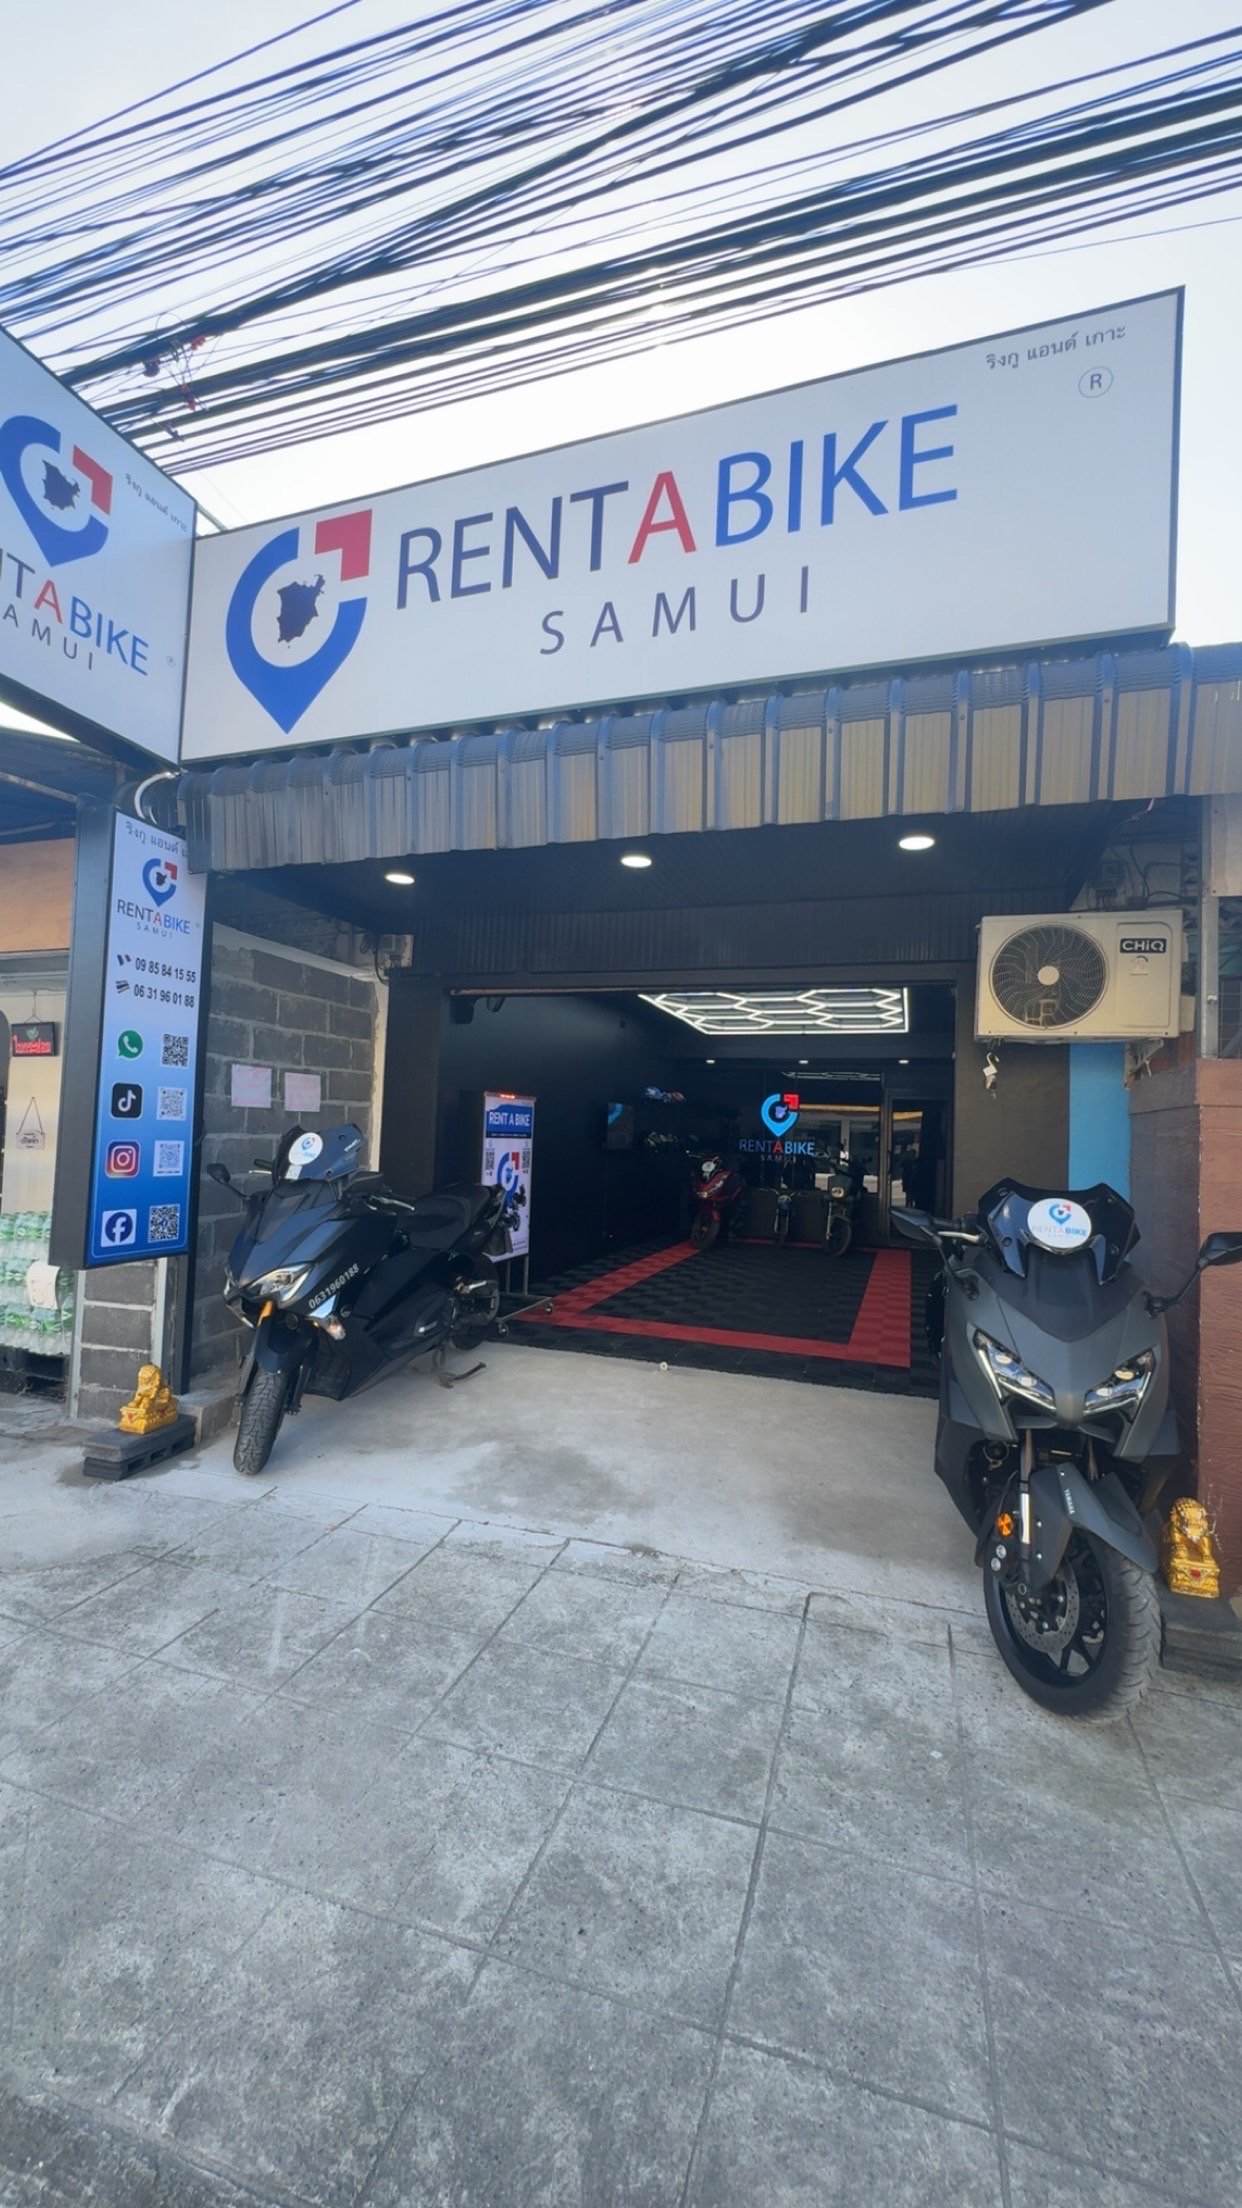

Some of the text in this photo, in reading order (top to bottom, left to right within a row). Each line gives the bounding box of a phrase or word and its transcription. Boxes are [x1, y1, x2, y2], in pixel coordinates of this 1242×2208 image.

[1027, 331, 1080, 361] แอนด์
[1086, 325, 1126, 347] เกาะ
[0, 548, 149, 677] TABIKE
[539, 566, 810, 655] SAMUI
[2, 604, 94, 671] AMUI
[117, 899, 191, 935] RENTABIKE
[136, 921, 173, 938] SAMUI
[135, 957, 147, 972] 09
[148, 961, 160, 975] 85
[161, 964, 172, 978] 84
[174, 968, 184, 981] 15
[134, 984, 145, 998] 06
[147, 987, 157, 1000] 31
[160, 990, 171, 1003] 96
[172, 992, 182, 1006] 01
[489, 1111, 530, 1126] RENT A BIKE
